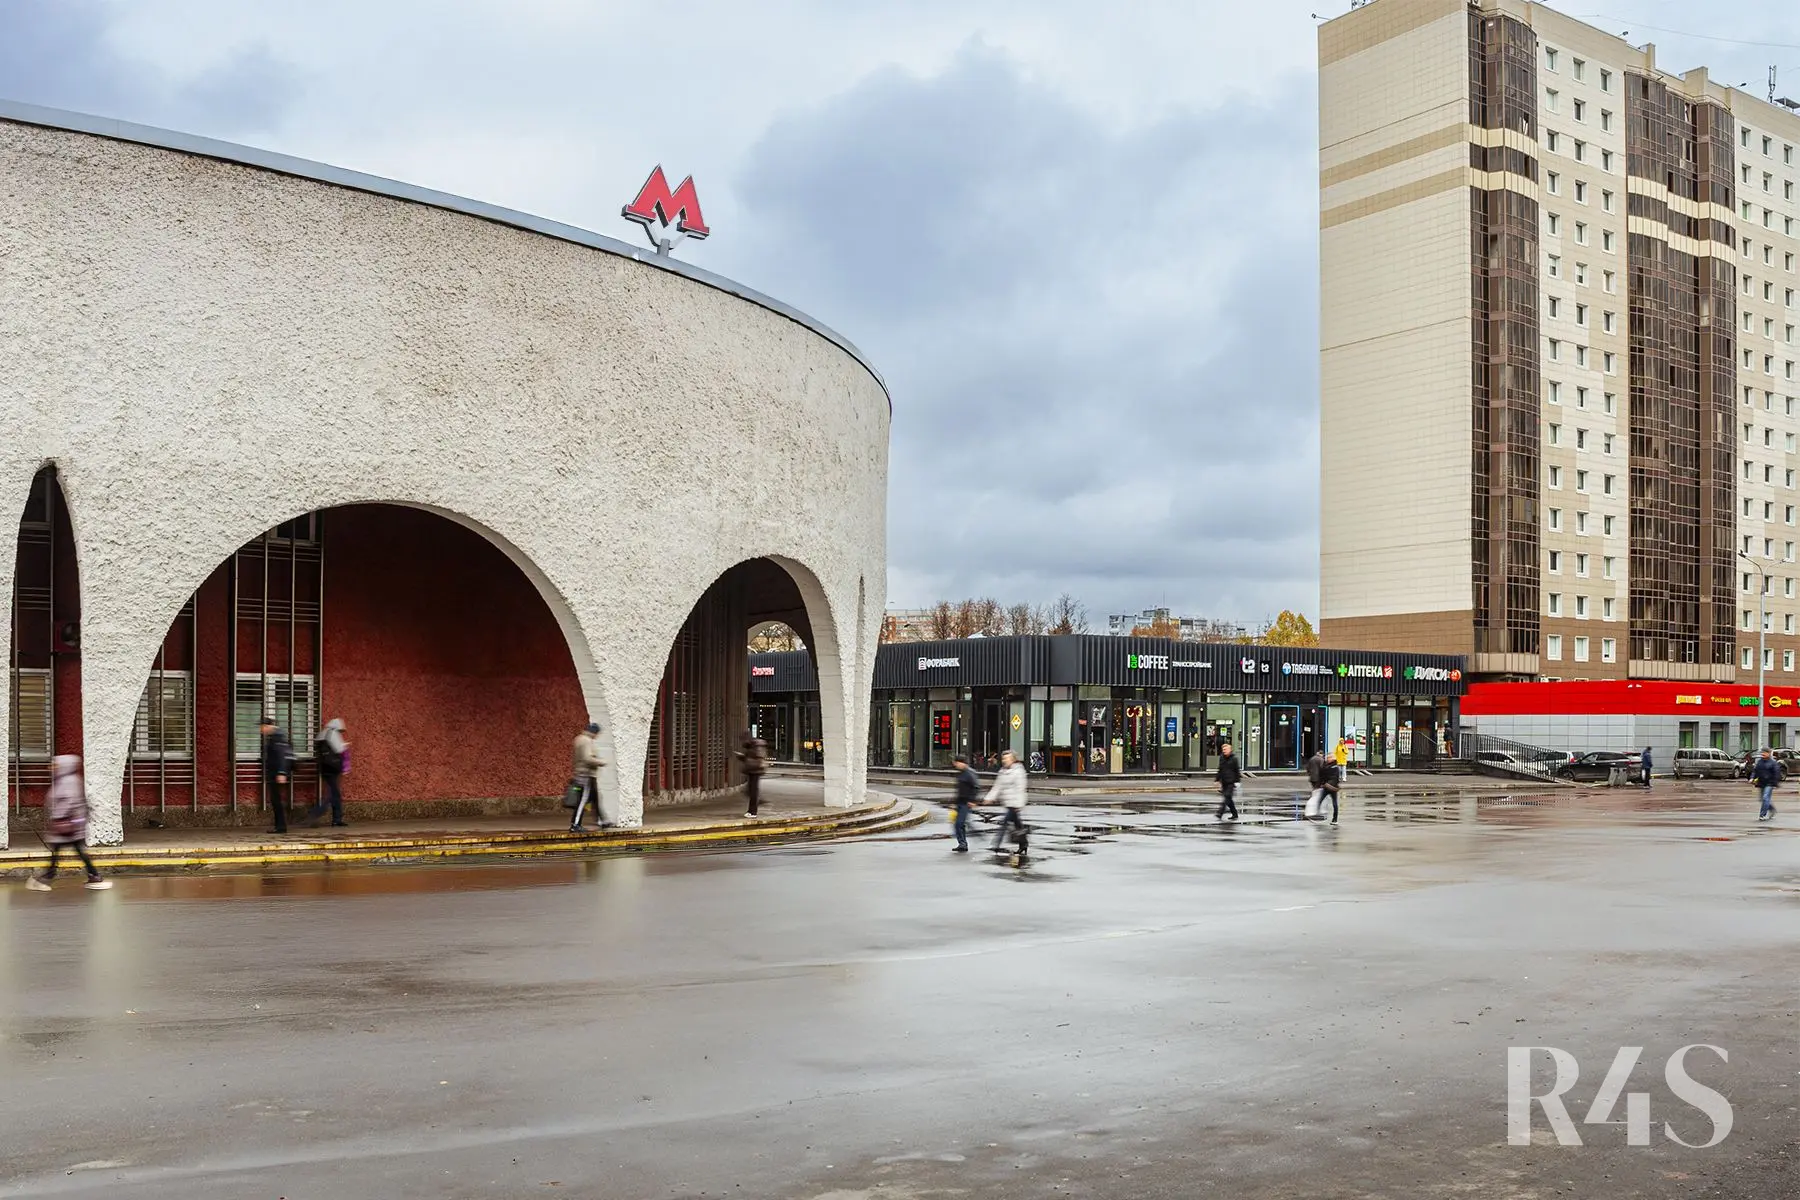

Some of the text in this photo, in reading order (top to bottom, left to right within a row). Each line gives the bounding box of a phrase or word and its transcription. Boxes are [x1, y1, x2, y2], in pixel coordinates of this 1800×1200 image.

[1138, 655, 1169, 670] COFFEE
[1347, 665, 1384, 678] АПТЕКА
[1413, 666, 1448, 681] ДИКСИ
